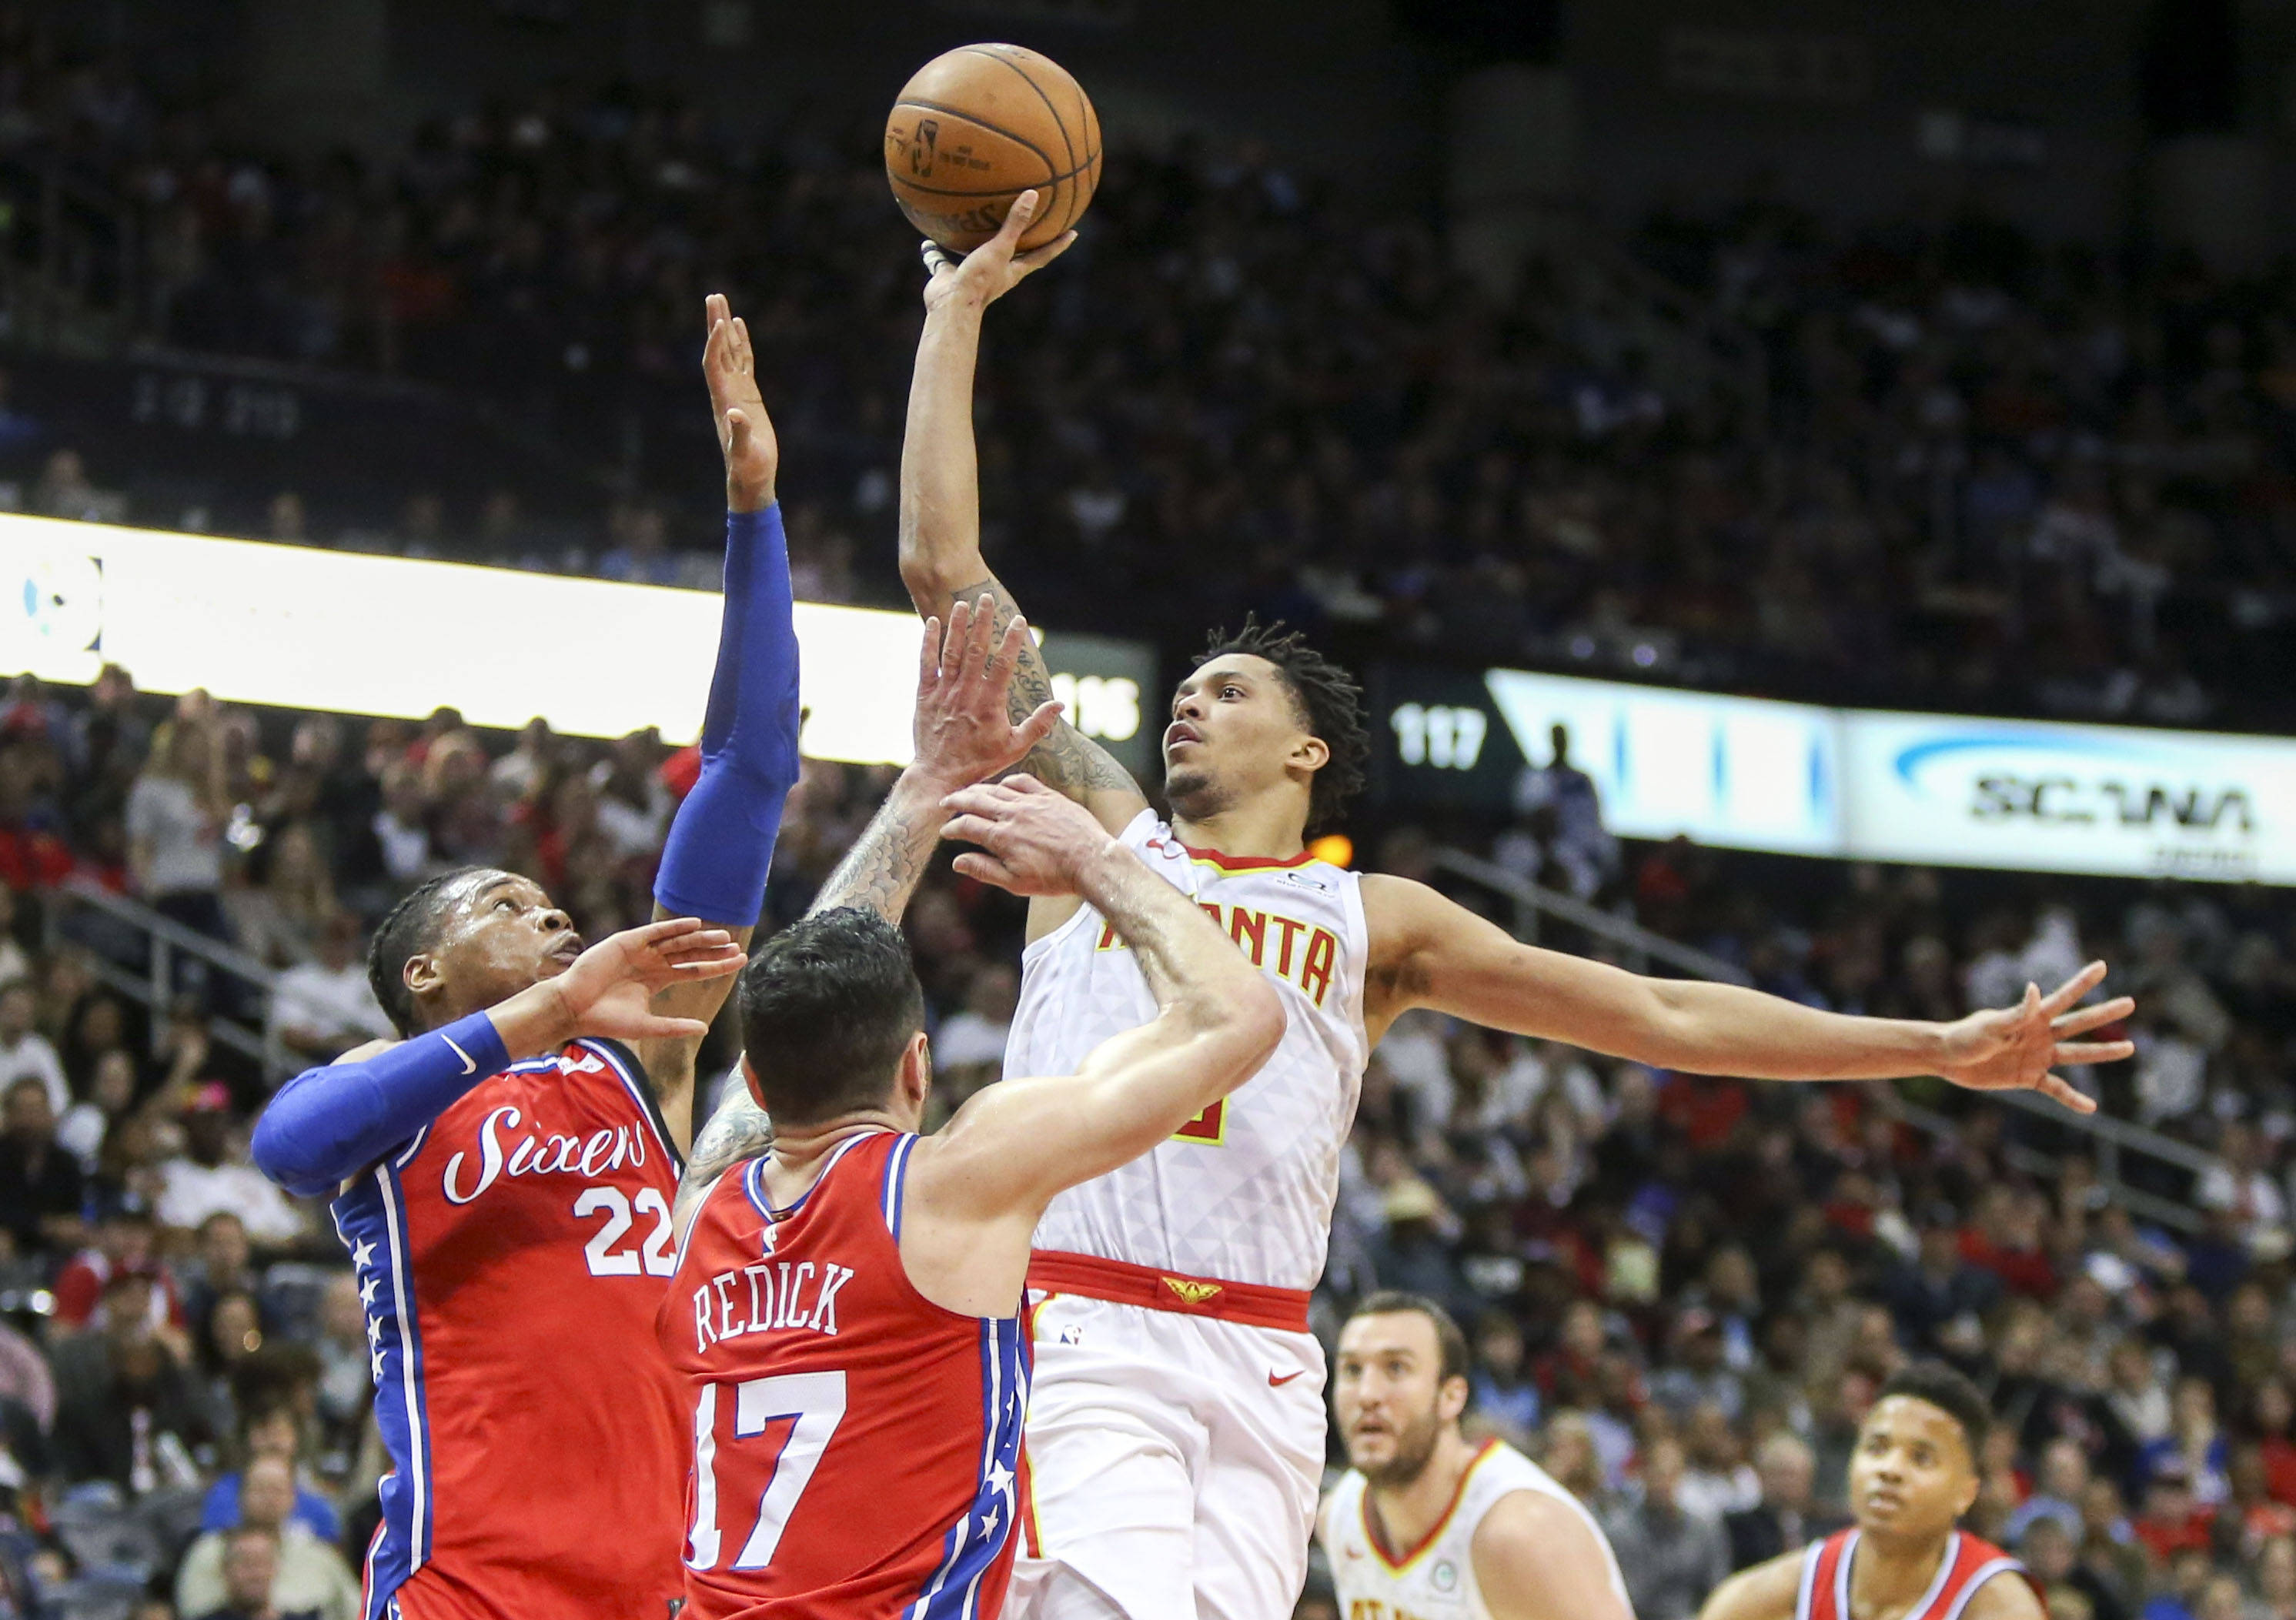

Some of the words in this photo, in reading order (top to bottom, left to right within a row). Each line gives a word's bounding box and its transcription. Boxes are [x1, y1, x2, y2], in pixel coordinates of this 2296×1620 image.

[1390, 702, 1487, 770] 117
[573, 1185, 677, 1277] 22
[693, 1262, 854, 1354] REDICK
[683, 1369, 847, 1571] 17
